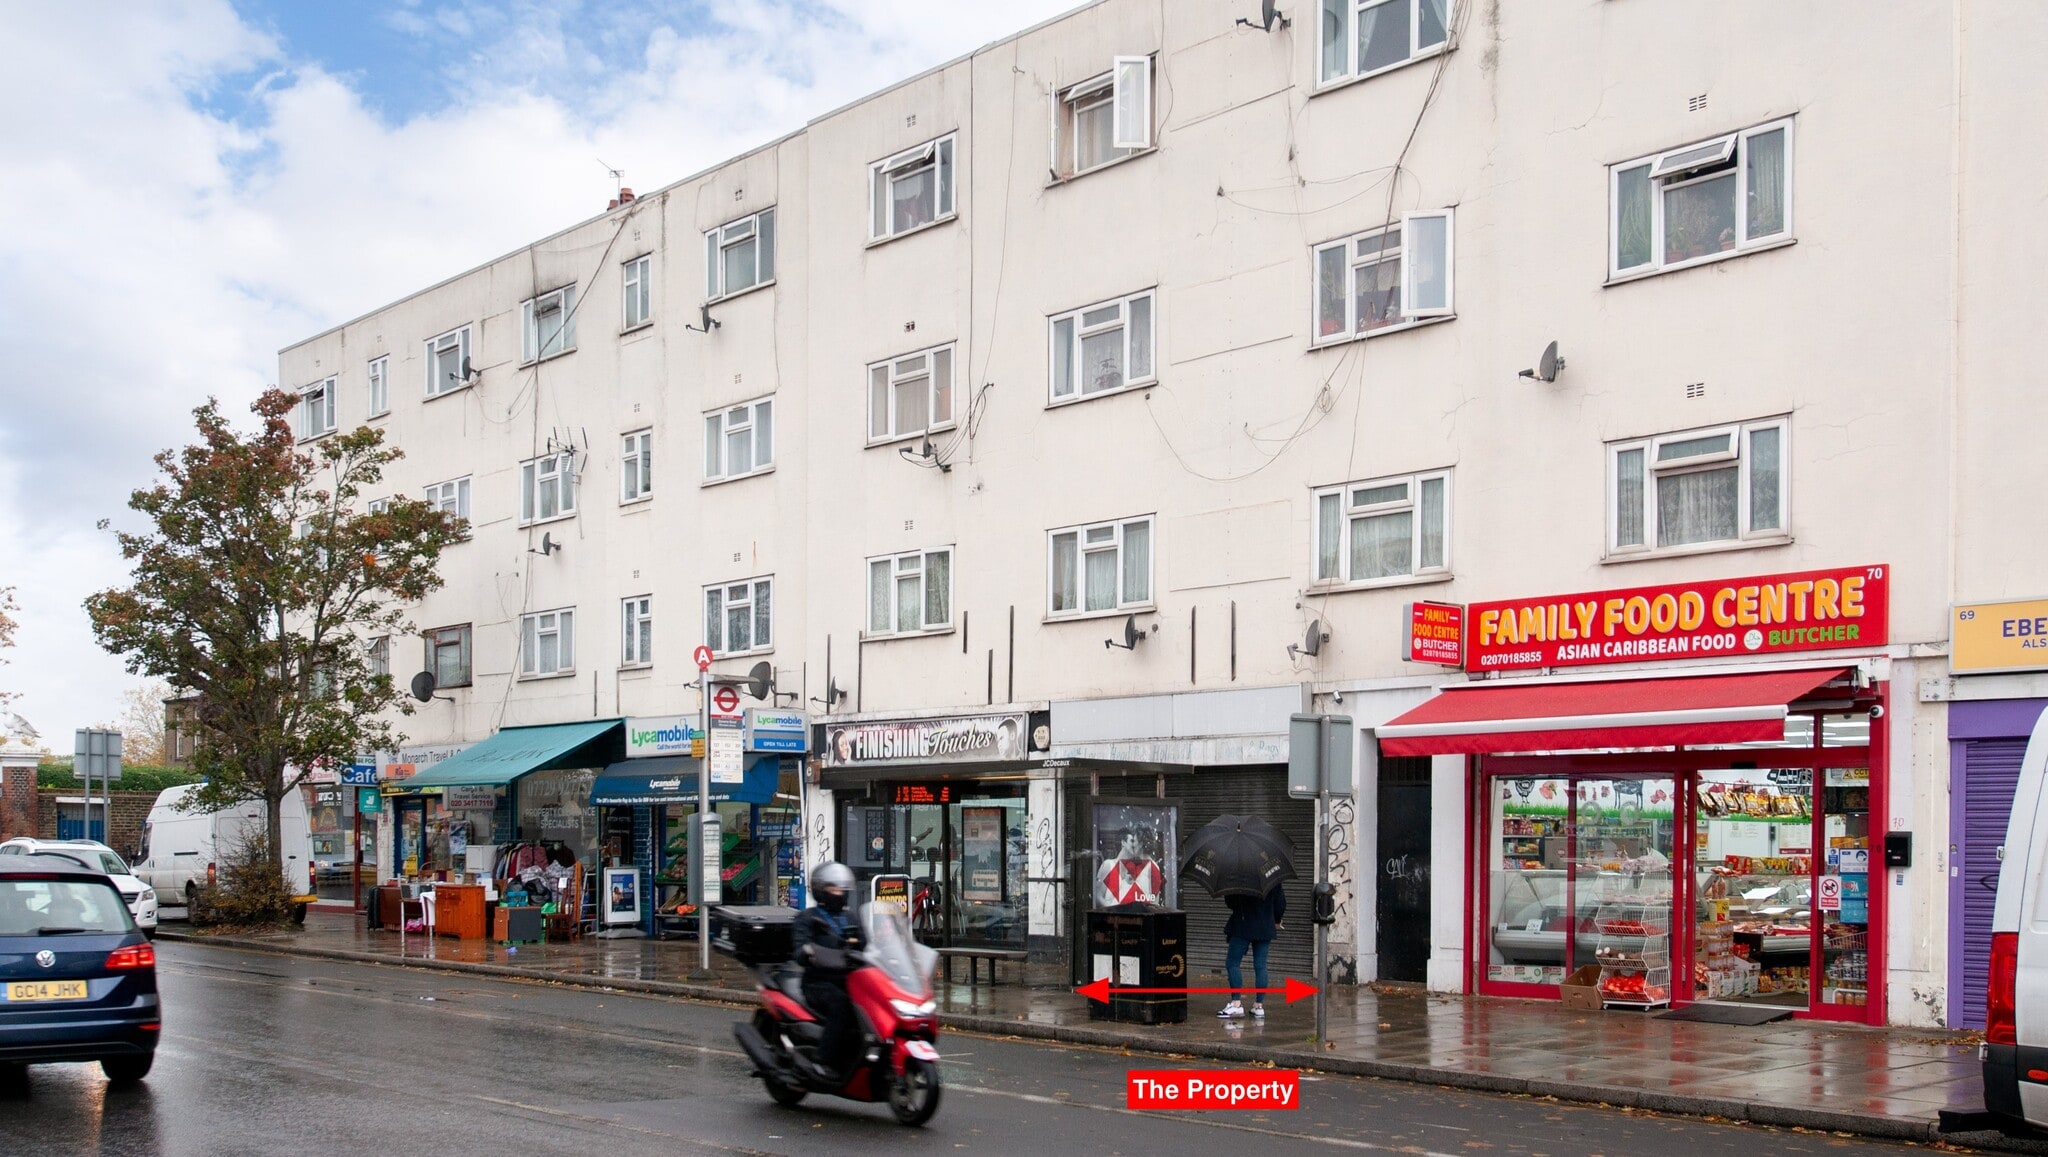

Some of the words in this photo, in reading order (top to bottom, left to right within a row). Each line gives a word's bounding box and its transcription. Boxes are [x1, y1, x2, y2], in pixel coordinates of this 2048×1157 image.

[1867, 567, 1883, 580] 70
[1424, 608, 1450, 623] FAMILY
[1479, 600, 1598, 646] FAMILY
[1603, 590, 1705, 637] FOOD
[1712, 576, 1866, 628] CENTRE
[1959, 610, 1975, 620] 69
[1413, 622, 1432, 637] FOOD
[1433, 625, 1459, 640] CENTRE
[2003, 617, 2048, 637] EBE
[1768, 624, 1860, 646] BUTCHER
[1422, 639, 1458, 651] BUTCHER
[1481, 651, 1542, 666] 02070185855
[1557, 643, 1600, 660] ASIAN
[1604, 636, 1688, 657] CARIBBEAN
[1692, 633, 1736, 651] FOOD
[697, 648, 711, 664] A
[757, 715, 803, 725] Lycamobile
[632, 724, 694, 747] Lycamobile
[856, 728, 929, 759] FINISHING
[928, 723, 994, 756] Touches
[402, 752, 429, 765] Monarch
[429, 750, 449, 762] Travel
[1042, 759, 1070, 767] JCDecaux
[540, 819, 579, 829] SPECIALISTS
[15, 984, 48, 998] GC14
[53, 983, 82, 997] JHK
